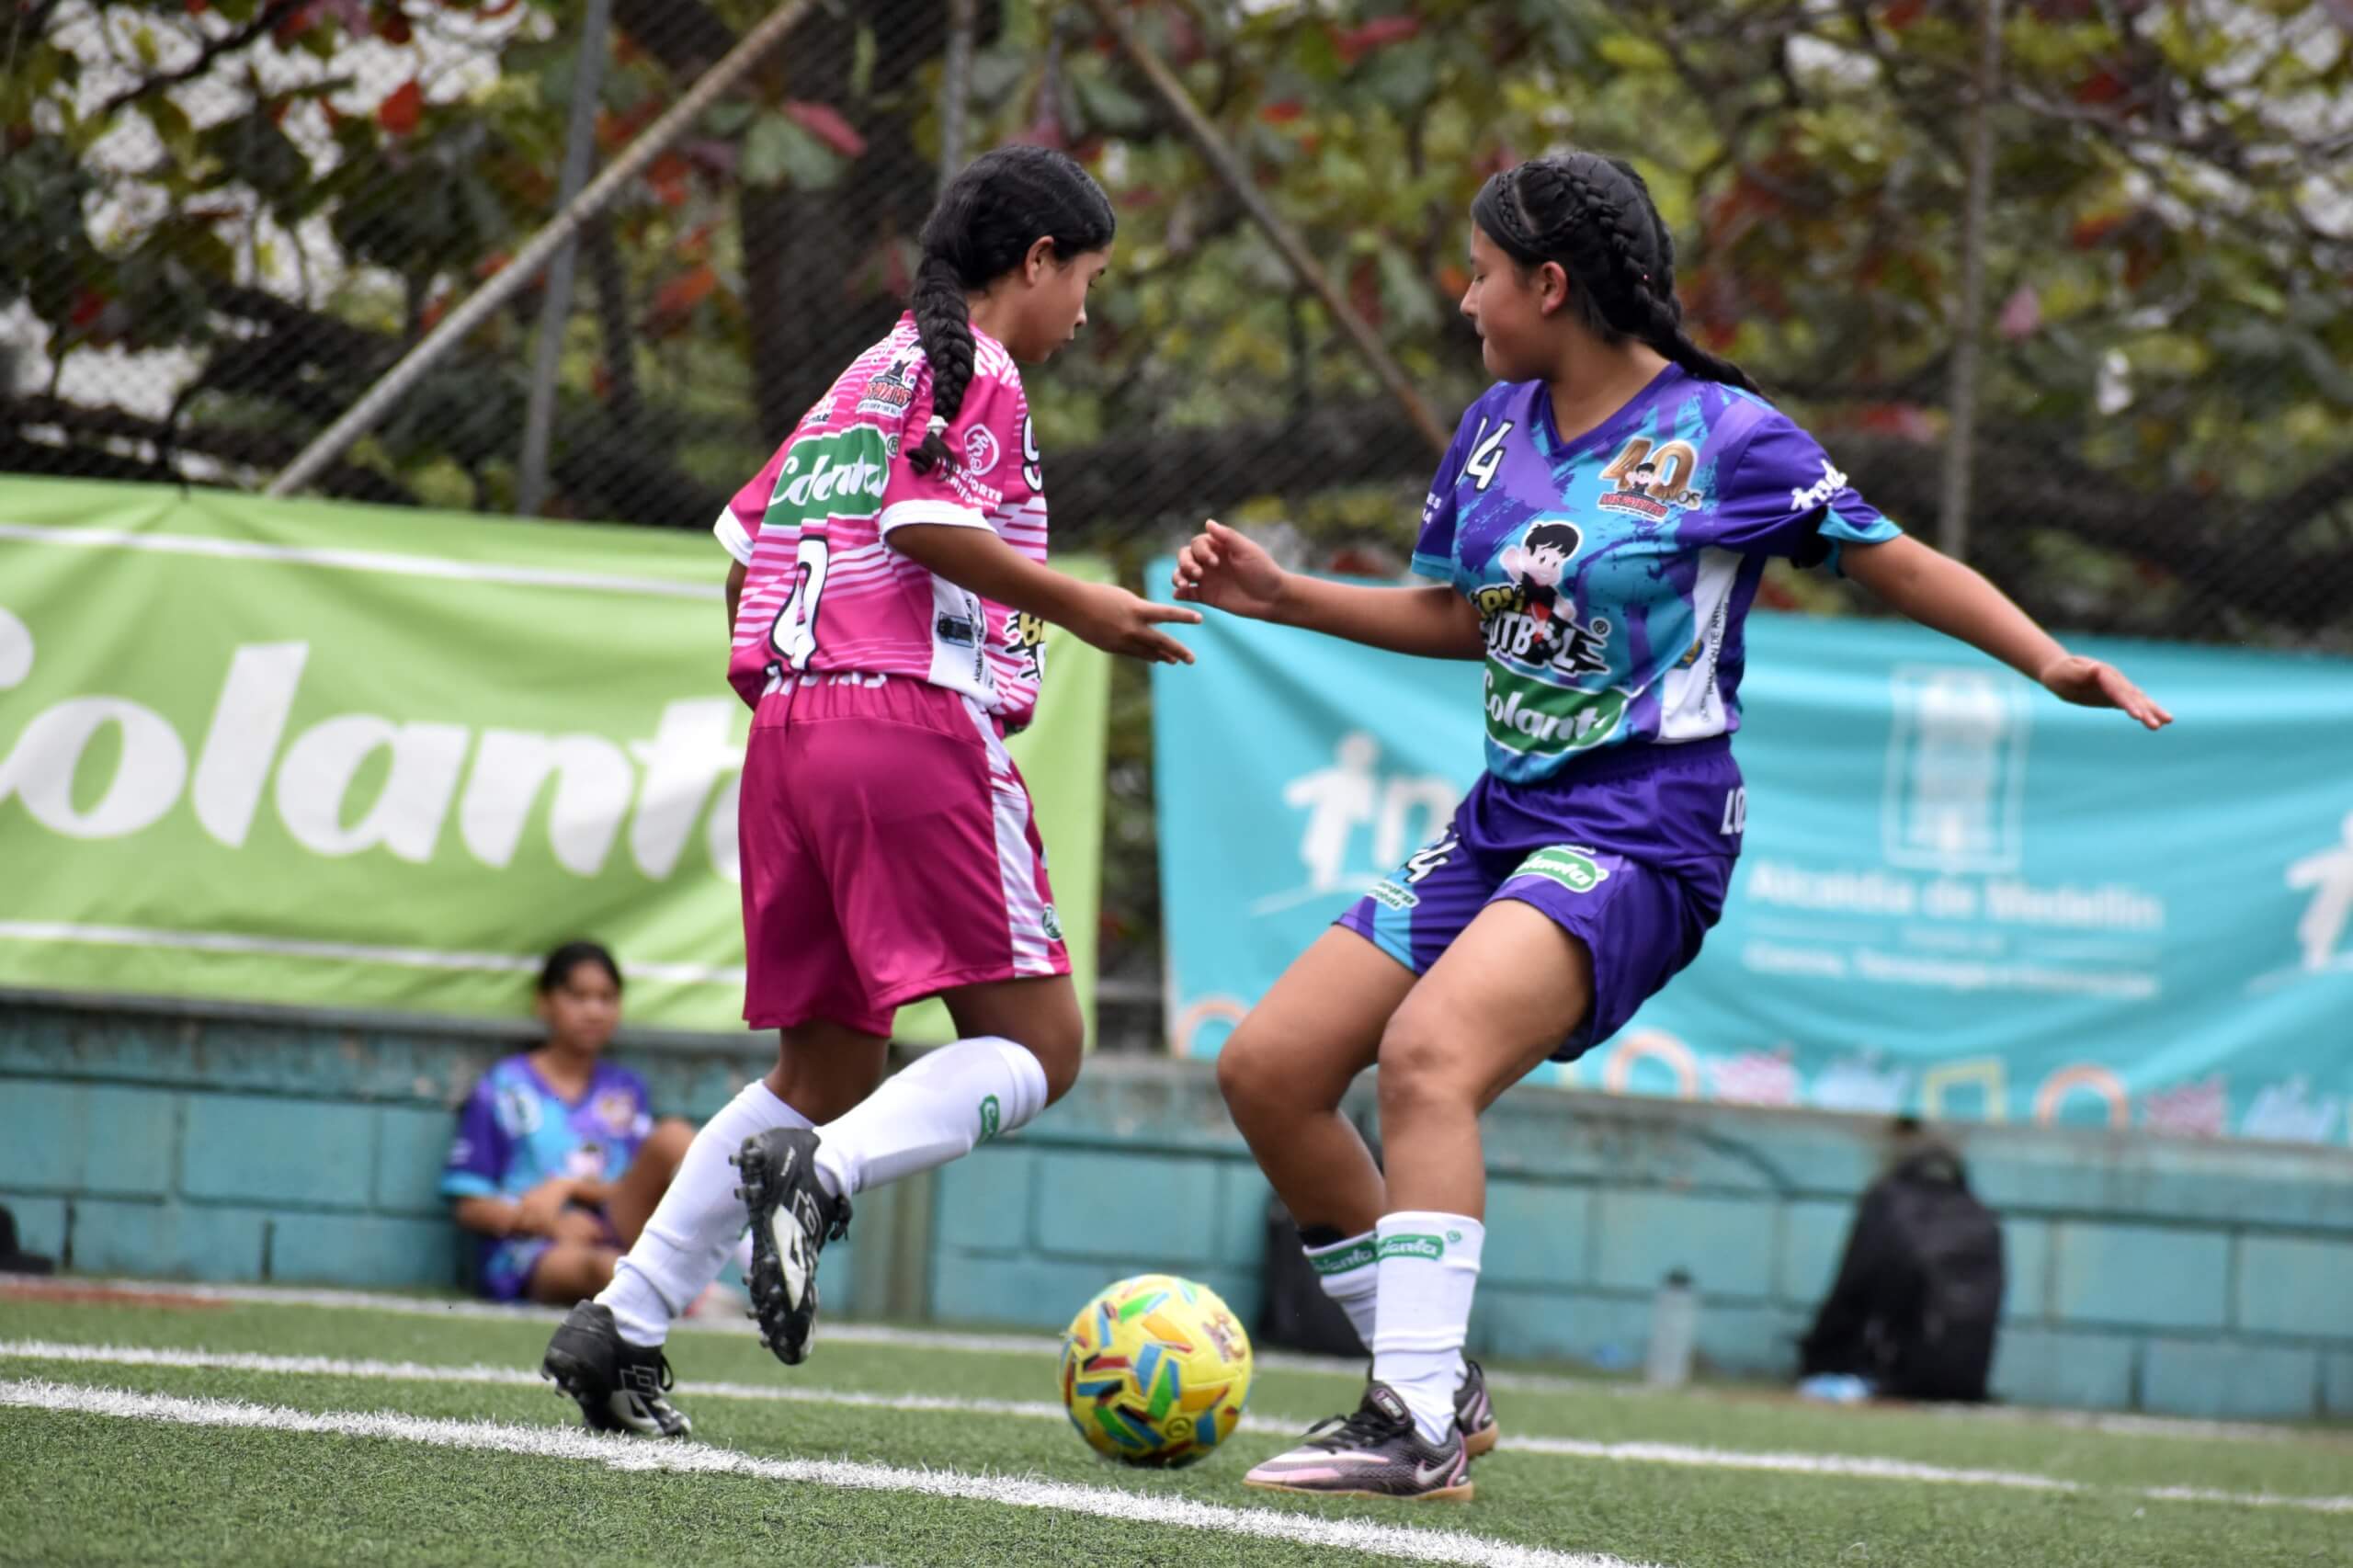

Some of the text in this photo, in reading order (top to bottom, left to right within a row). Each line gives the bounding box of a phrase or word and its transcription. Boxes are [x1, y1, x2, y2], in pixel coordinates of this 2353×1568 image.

[1600, 438, 1696, 497] 40
[1483, 668, 1610, 741] Colant
[0, 607, 741, 881] olant
